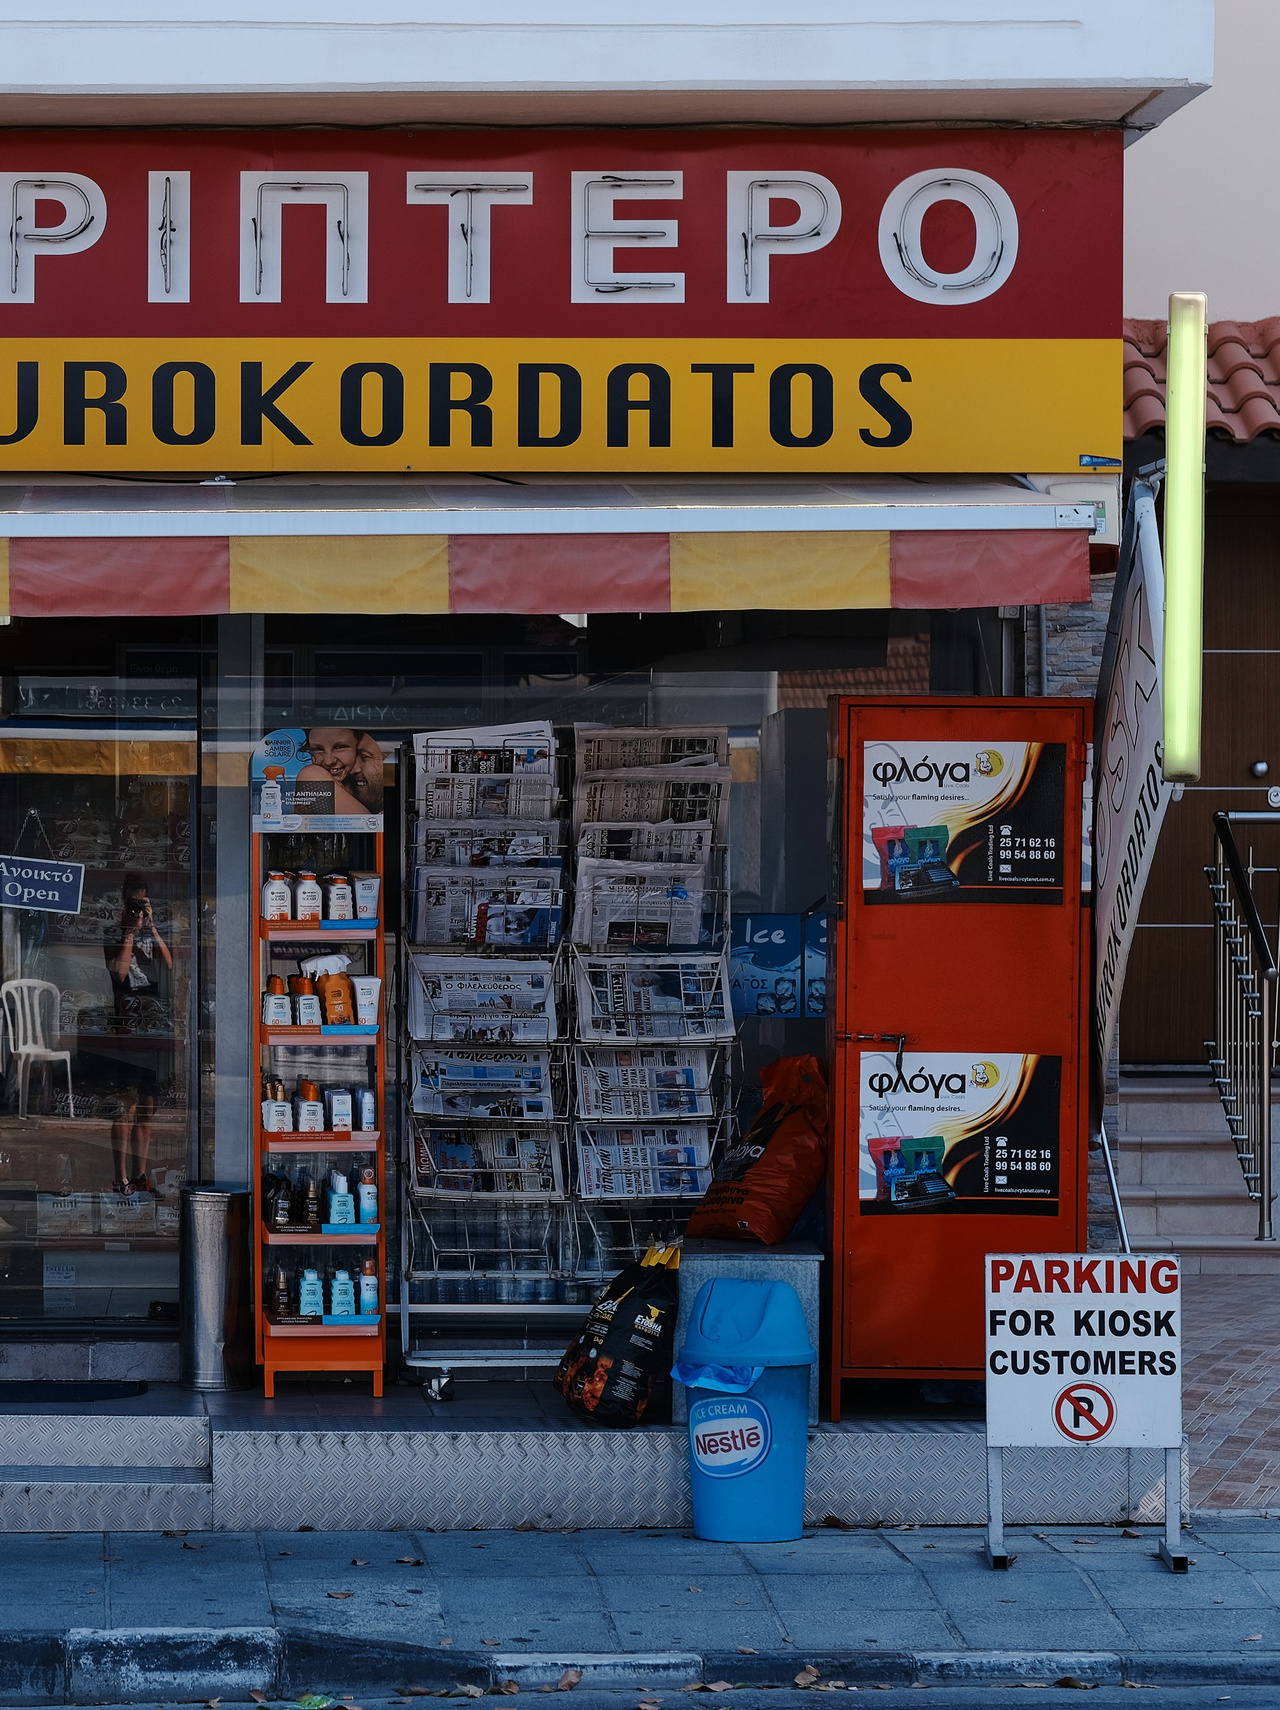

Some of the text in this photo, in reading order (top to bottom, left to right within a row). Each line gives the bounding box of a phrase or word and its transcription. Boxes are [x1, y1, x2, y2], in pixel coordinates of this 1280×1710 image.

[265, 739, 291, 747] GARNIER
[872, 755, 970, 788] φλόγα
[872, 794, 894, 802] Satisfy
[912, 794, 939, 802] flaming
[1000, 838, 1055, 847] 25 71 62 16
[1000, 850, 1056, 860] 99 54 88 60
[5, 880, 61, 903] Open
[358, 905, 367, 913] 50
[745, 917, 787, 944] Ice
[457, 981, 522, 991] Φιλελεύθερος
[868, 1066, 966, 1099] φλόγα
[869, 1104, 890, 1113] Satisfy
[908, 1104, 935, 1113] flaming
[995, 1149, 1051, 1159] 25 71 62 16
[995, 1161, 1051, 1171] 99 54 88 60
[52, 1199, 77, 1208] mini
[116, 1197, 141, 1207] mini
[990, 1259, 1179, 1294] PARKING
[634, 1314, 664, 1332] ETOSHA
[989, 1309, 1177, 1338] FOR KIOSK
[989, 1350, 1177, 1376] CUSTOMERS
[694, 1403, 748, 1420] ICE CREAM
